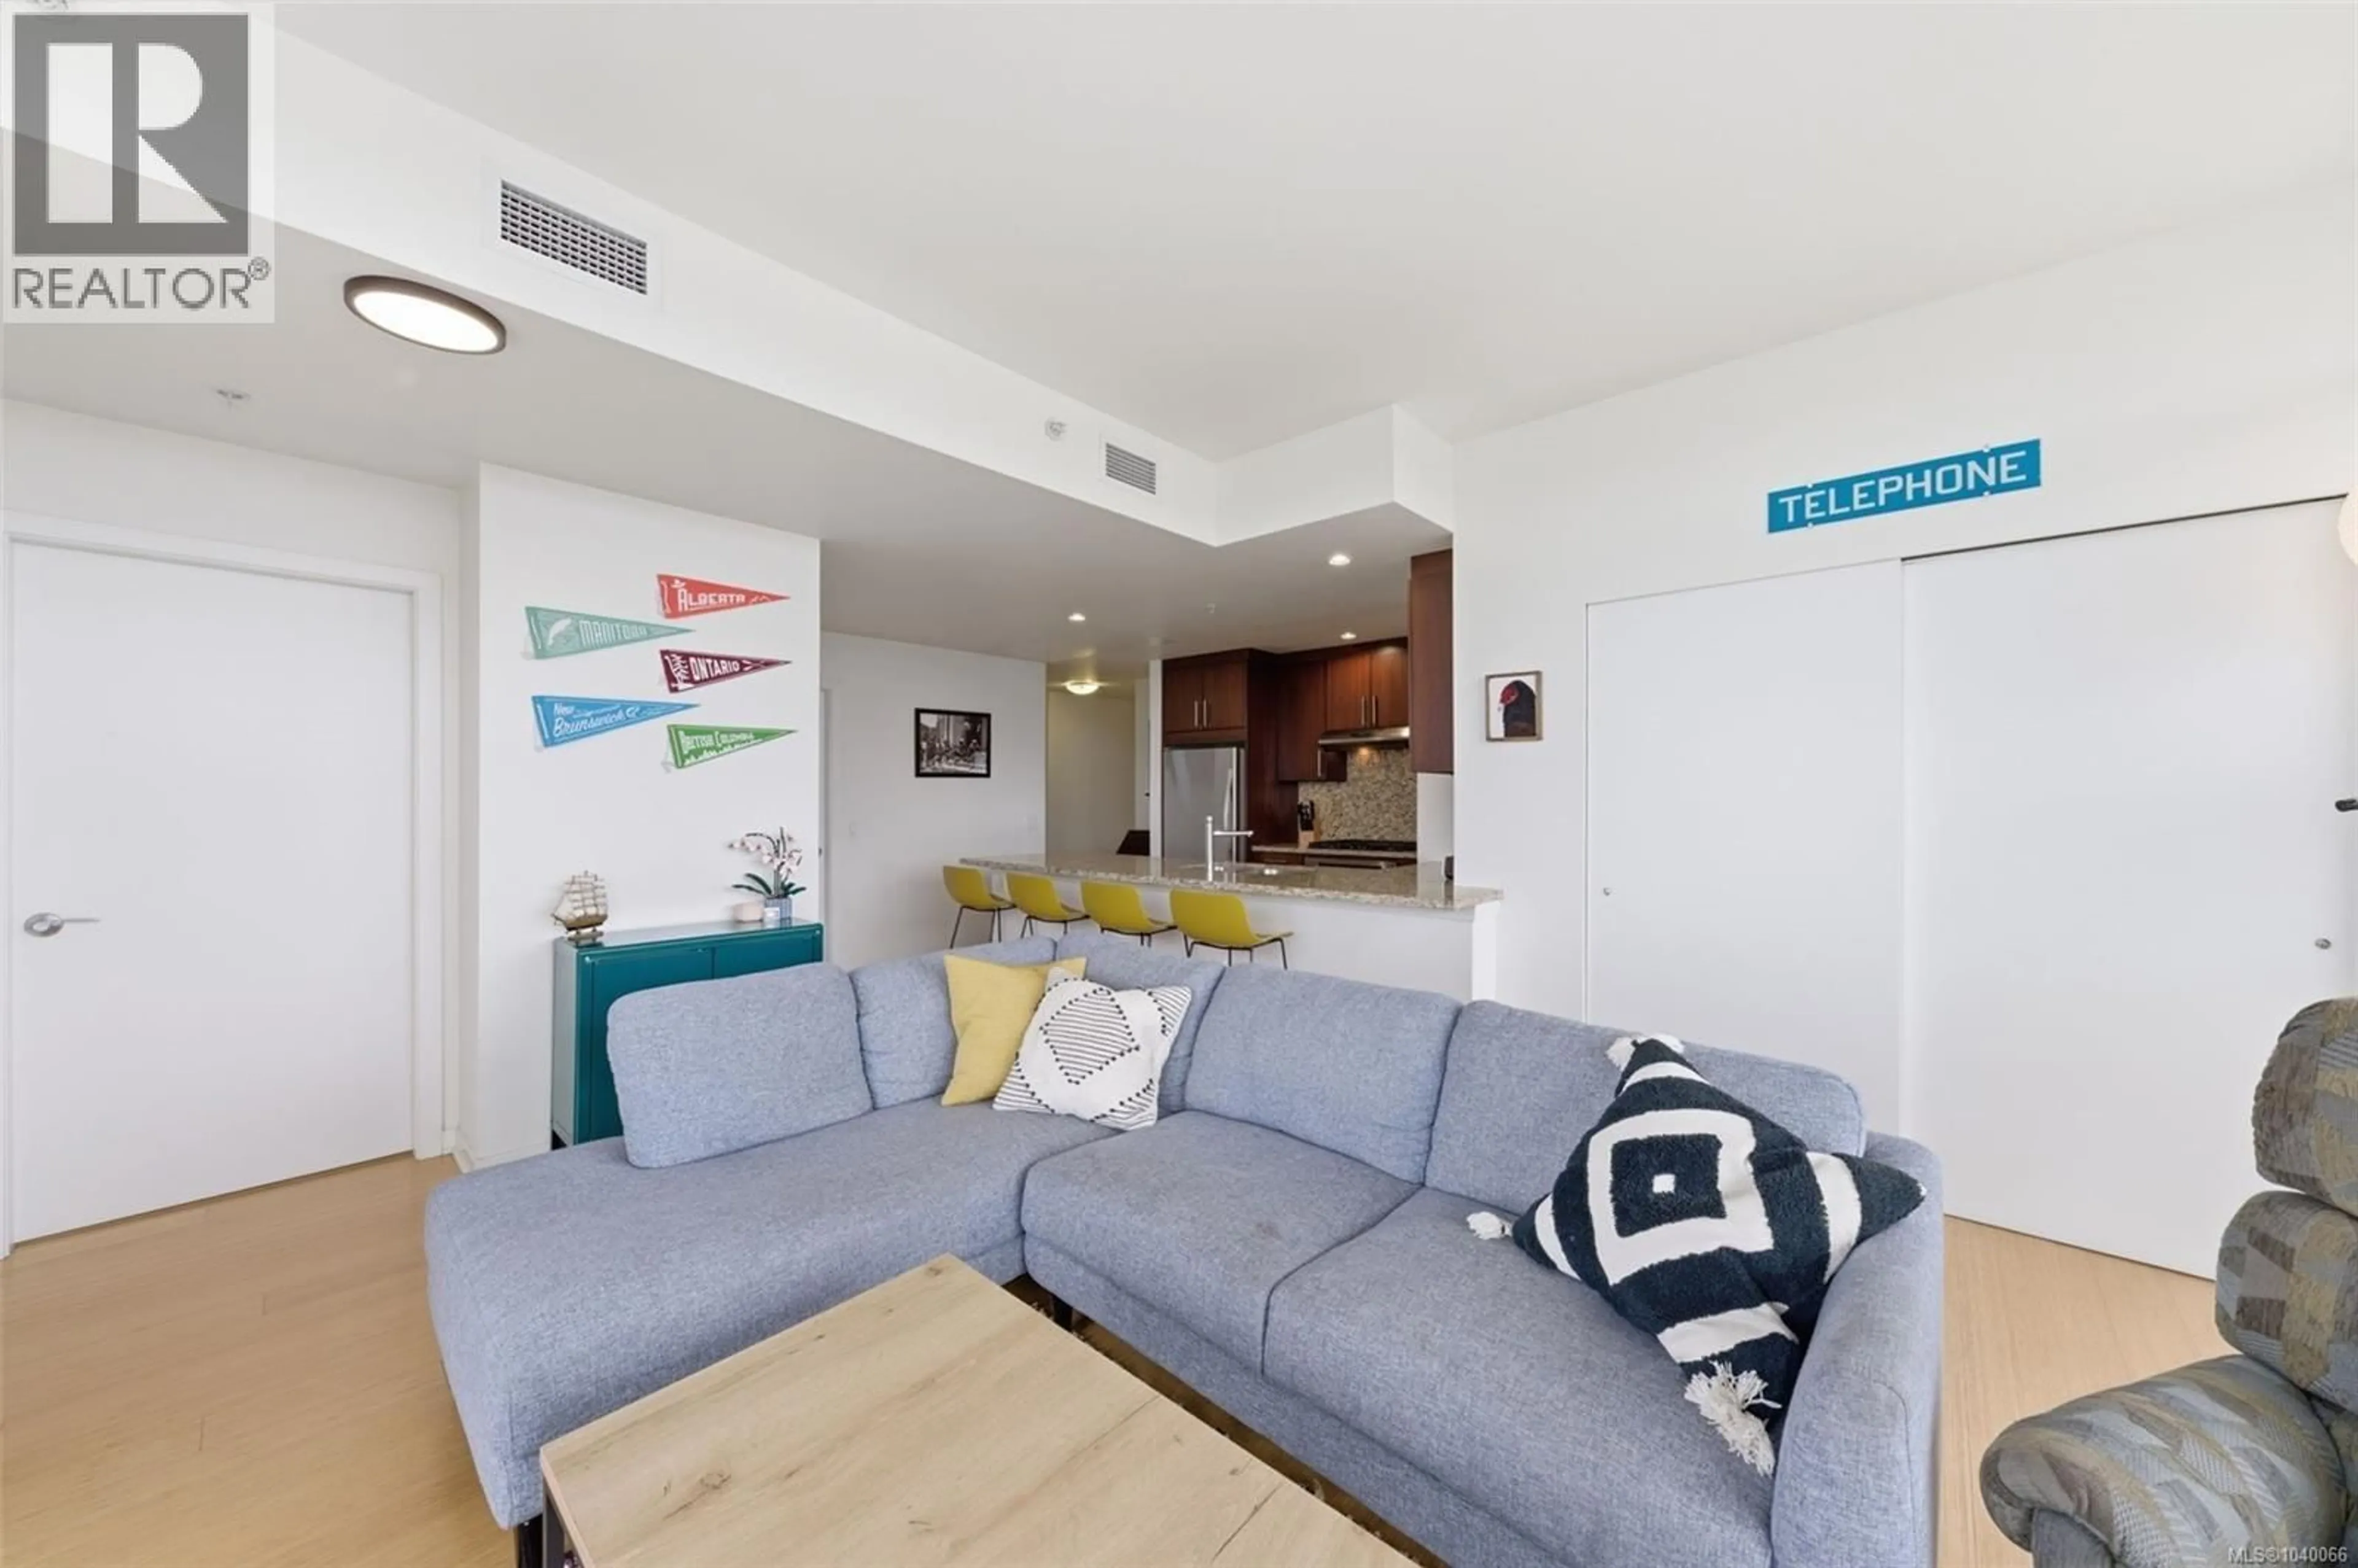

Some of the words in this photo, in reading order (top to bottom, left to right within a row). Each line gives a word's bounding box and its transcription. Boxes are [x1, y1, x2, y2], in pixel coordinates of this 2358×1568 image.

[1779, 451, 2026, 522] TELEPHONE
[578, 620, 647, 646] MANITOBA
[688, 656, 740, 681] ONTARIO
[554, 703, 574, 716] New
